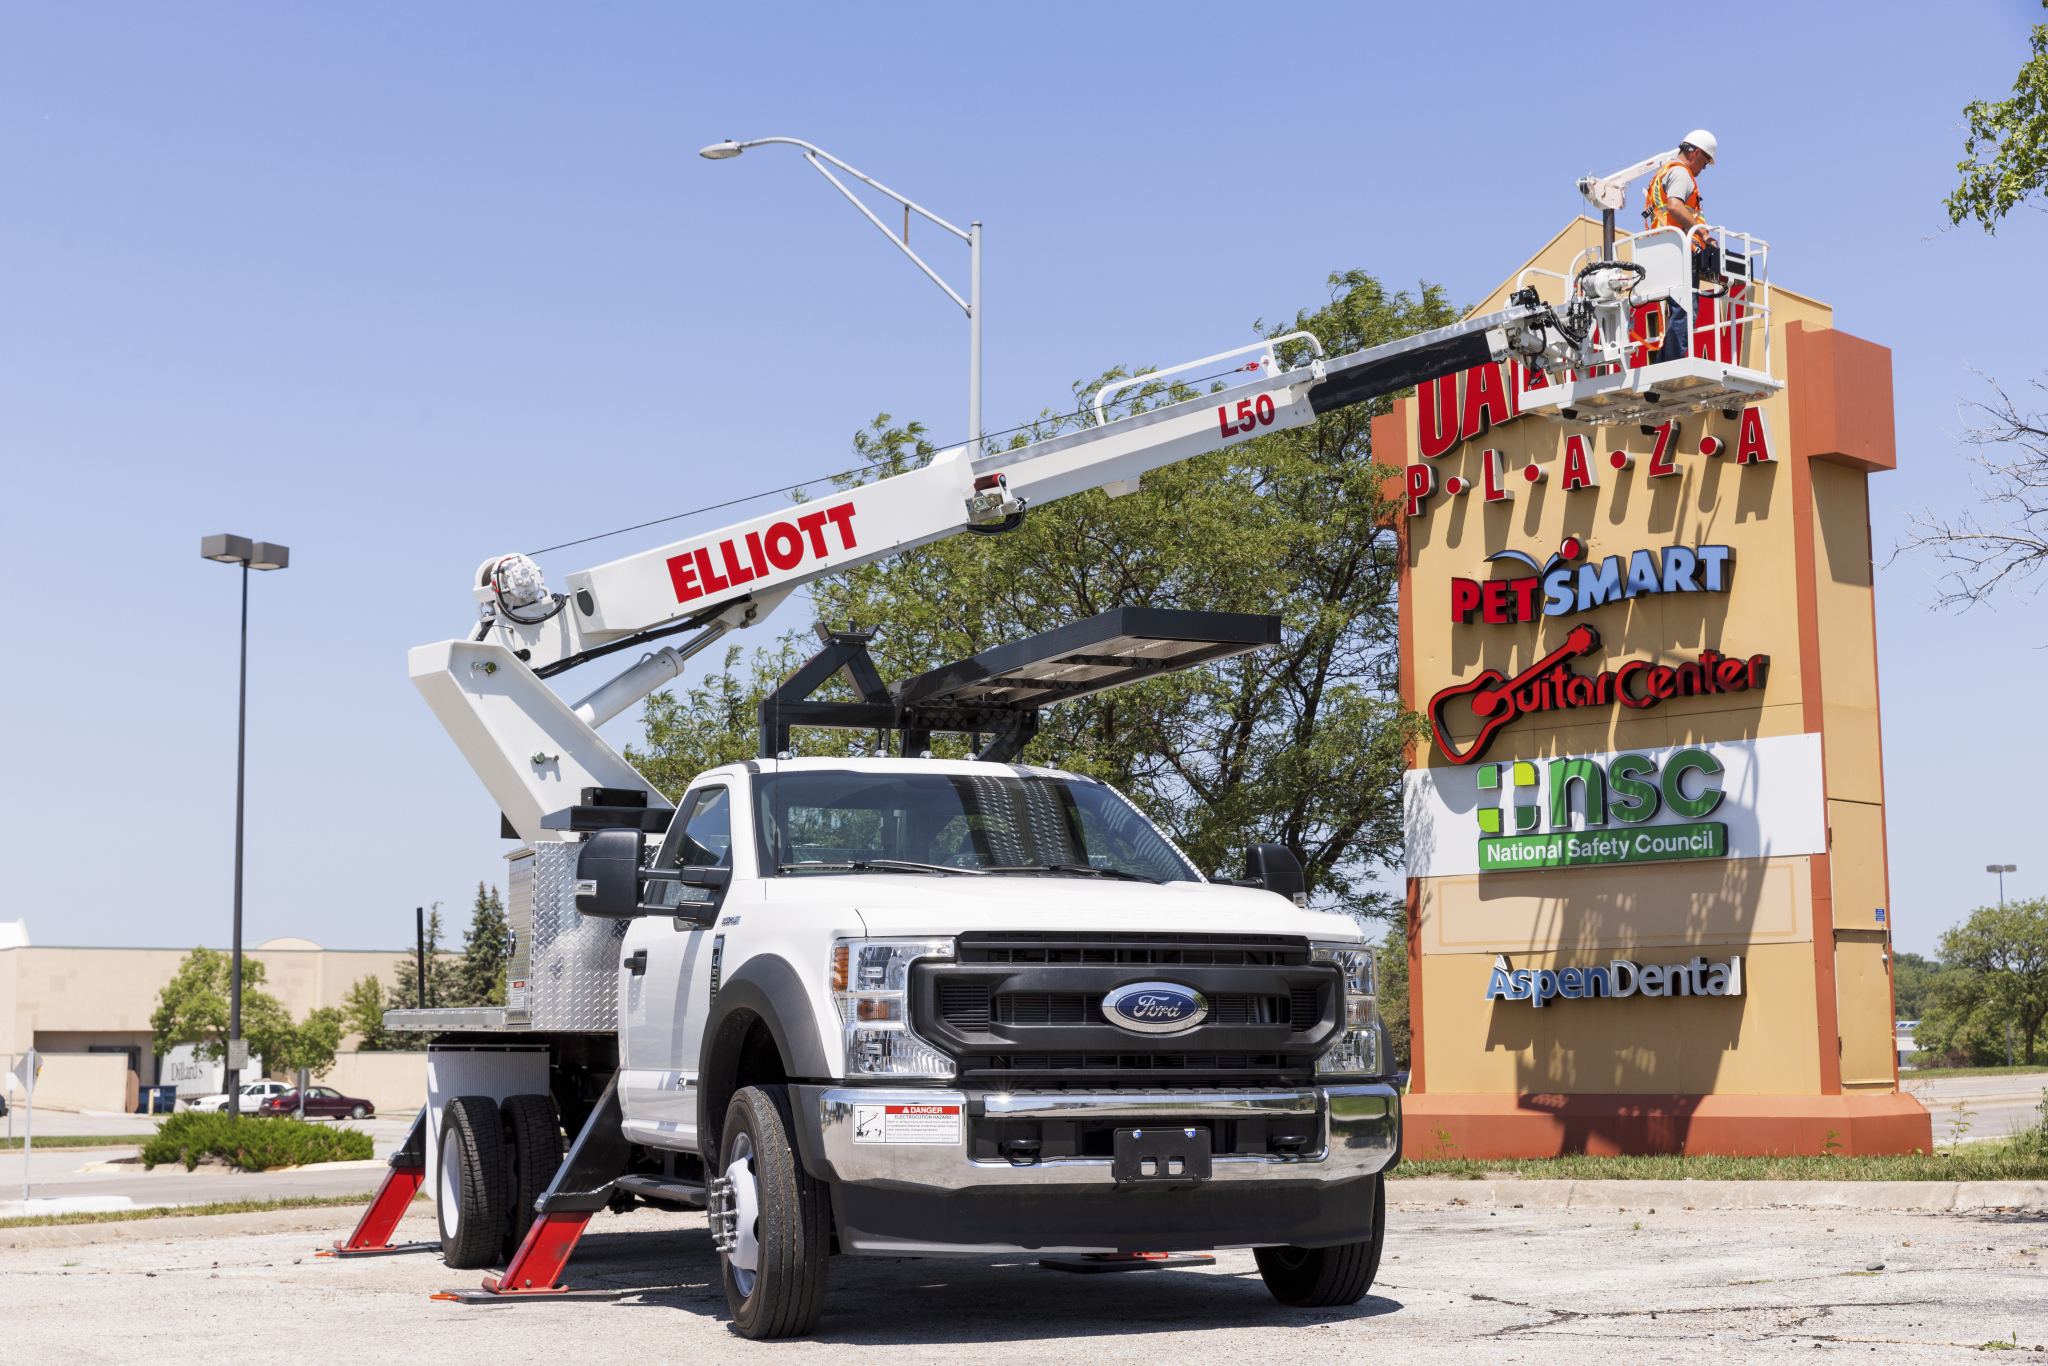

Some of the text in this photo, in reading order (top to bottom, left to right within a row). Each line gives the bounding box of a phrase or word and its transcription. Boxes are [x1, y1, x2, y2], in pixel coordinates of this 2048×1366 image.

[1218, 394, 1276, 439] L50
[667, 502, 857, 604] ELLIOTT
[1548, 748, 1725, 829] nsc
[1486, 830, 1713, 863] National Safety Council
[1132, 994, 1182, 1020] Ford
[910, 1106, 943, 1114] DANGER
